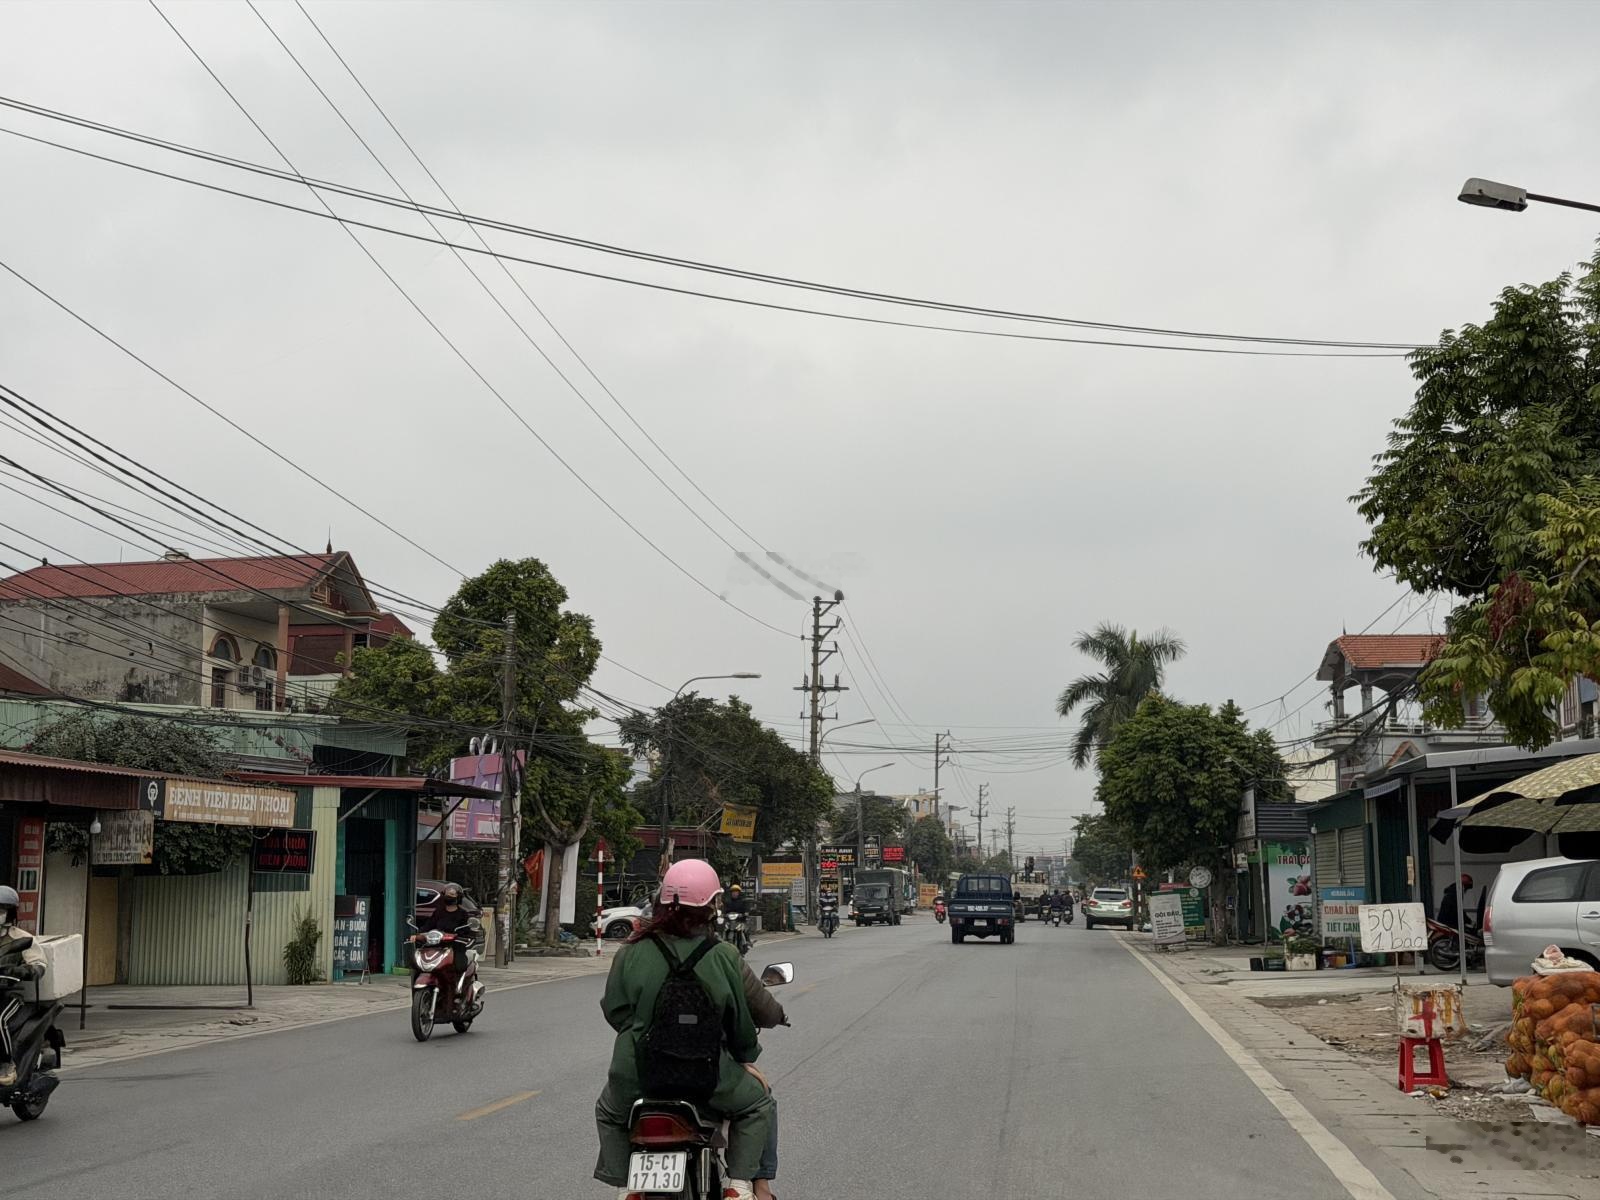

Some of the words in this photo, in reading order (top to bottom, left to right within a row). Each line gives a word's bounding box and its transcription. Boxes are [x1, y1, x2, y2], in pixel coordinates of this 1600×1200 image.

[259, 795, 291, 817] THOẠI
[1371, 931, 1385, 951] 1
[1391, 931, 1423, 950] bao
[639, 1154, 677, 1171] 15-C1
[633, 1172, 681, 1189] 171.30
